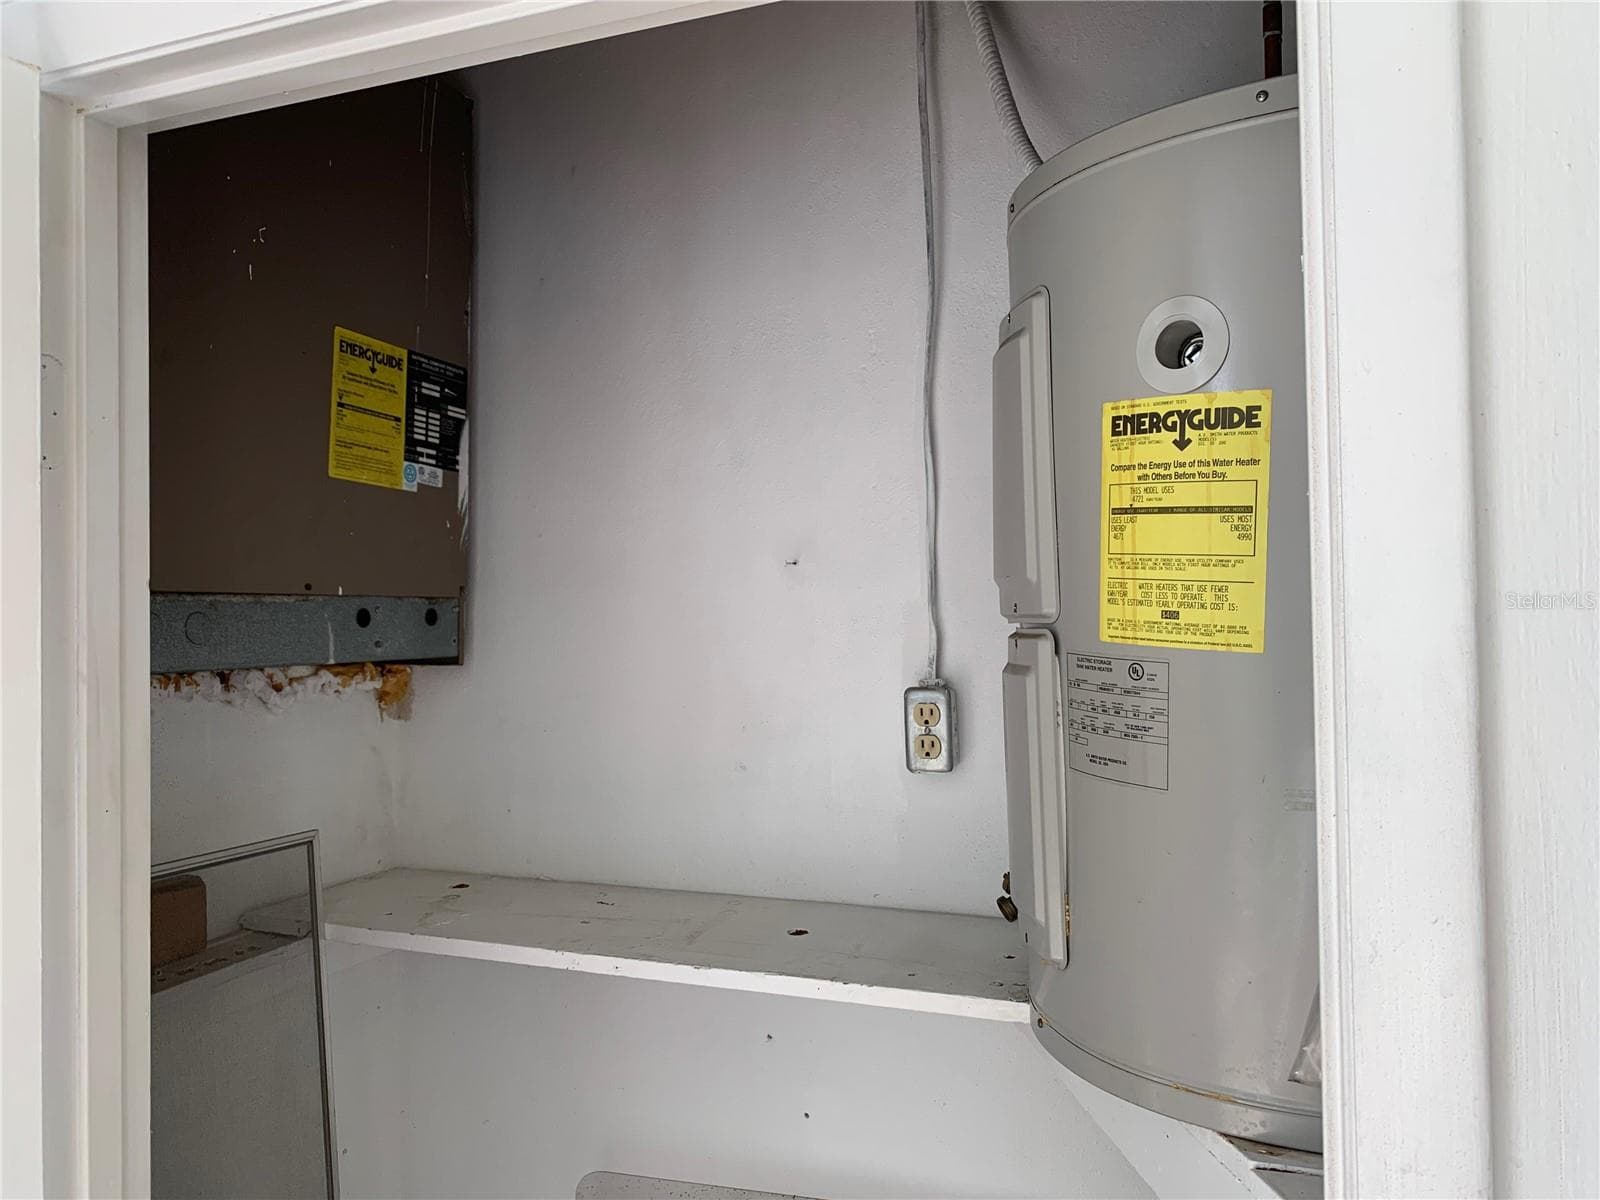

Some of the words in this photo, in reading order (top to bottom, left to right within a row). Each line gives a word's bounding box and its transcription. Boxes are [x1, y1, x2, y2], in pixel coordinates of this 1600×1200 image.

[340, 339, 403, 372] ENERGYGUIDE
[1111, 405, 1262, 445] ENERGYGUIDE
[1111, 463, 1136, 473] Compare
[1137, 461, 1148, 470] the
[1149, 461, 1172, 471] Energy
[1173, 460, 1187, 468] Use
[1188, 459, 1196, 468] of
[1197, 459, 1211, 468] this
[1212, 458, 1234, 467] Water
[1235, 457, 1261, 466] Heater
[1137, 472, 1150, 481] with
[1151, 472, 1173, 480] Others
[1174, 471, 1196, 480] Before
[1197, 470, 1210, 479] You
[1212, 470, 1228, 480] Buy.
[1130, 487, 1142, 495] THIS
[1144, 486, 1159, 494] MODEL
[1161, 486, 1175, 494] USES
[1132, 495, 1144, 503] 4721
[1111, 516, 1122, 524] USES
[1124, 516, 1137, 524] LEAST
[1219, 515, 1235, 523] USES
[1237, 515, 1253, 523] MOST
[1111, 524, 1127, 532] ENERGY
[1230, 524, 1253, 532] ENERGY
[1237, 533, 1253, 541] 4990
[1108, 581, 1128, 589] ELECTRIC
[1155, 583, 1178, 591] HEATERS
[1181, 584, 1194, 592] THAT
[1197, 584, 1208, 592] USE
[1211, 585, 1229, 593] FEWER
[1156, 591, 1168, 599] LESS
[1171, 592, 1178, 600] TO
[1180, 592, 1207, 601] OPERATE.
[1214, 594, 1229, 602] THIS
[1108, 598, 1125, 606] MODEL'S
[1127, 598, 1153, 607] ESTIMATED
[1156, 600, 1175, 608] YEARLY
[1177, 601, 1207, 610] OPERATING
[1210, 602, 1225, 610] COST
[1228, 603, 1239, 611] IS:
[1093, 658, 1112, 666] STORAGE
